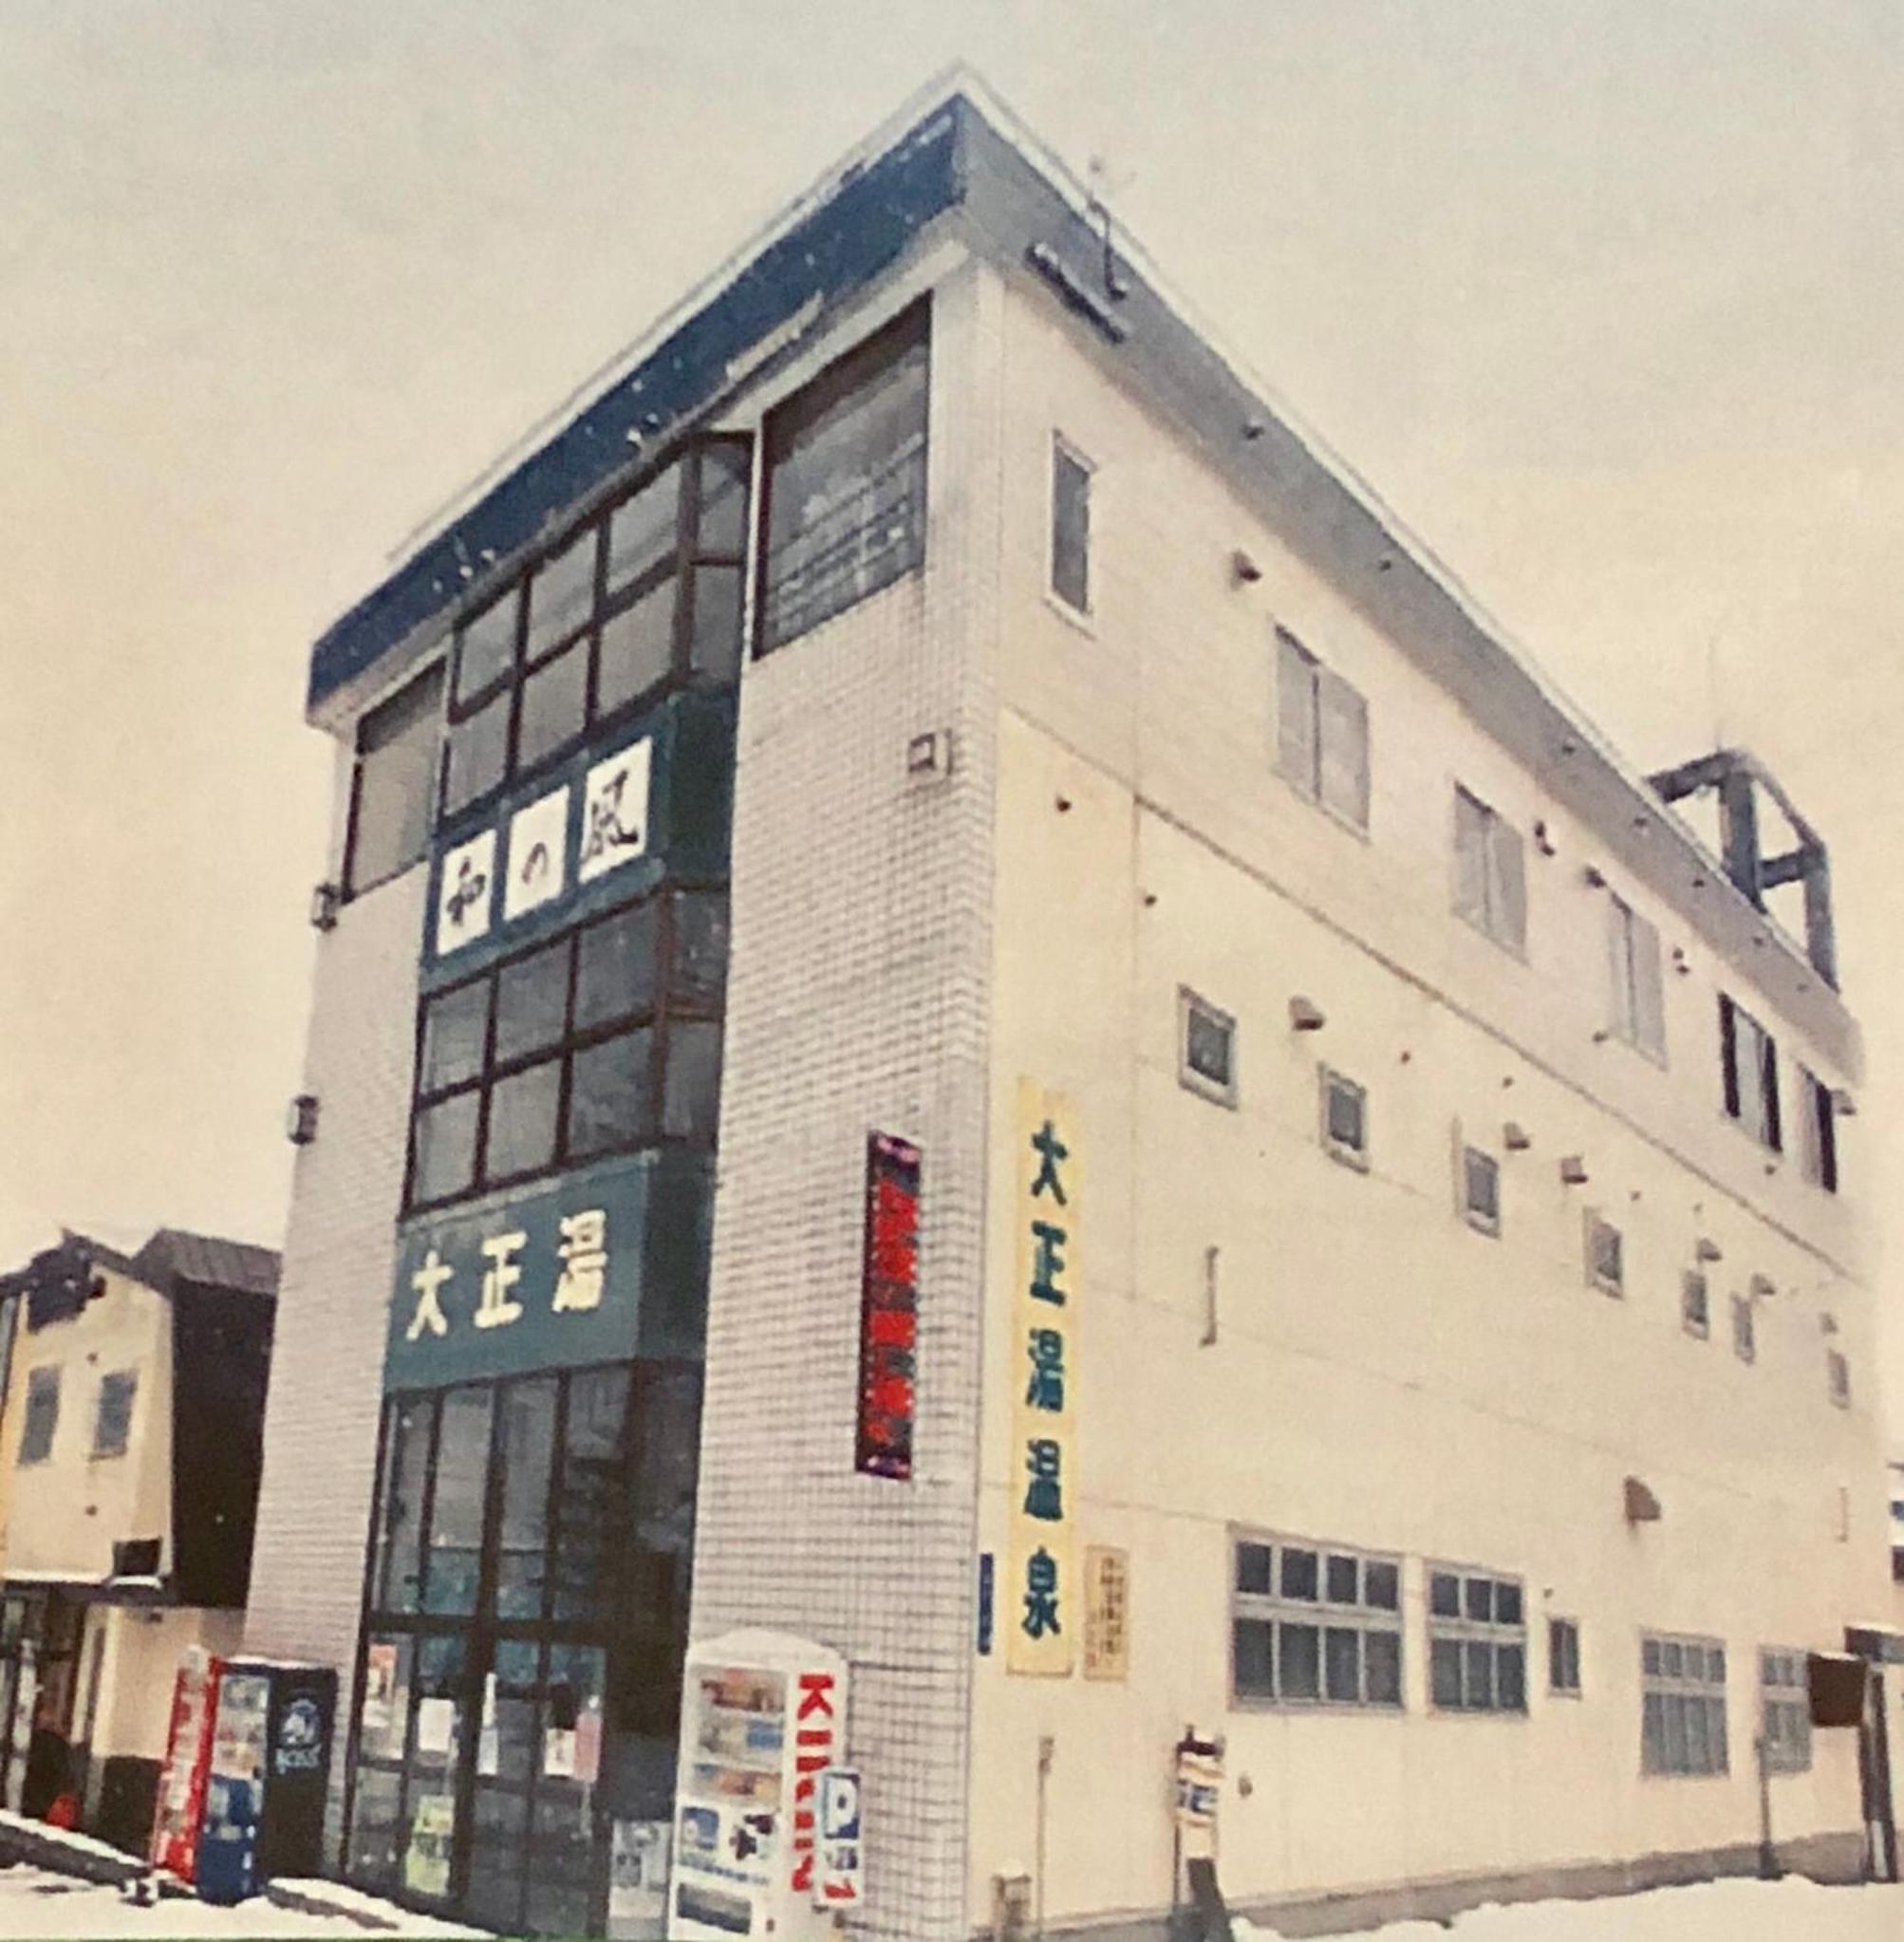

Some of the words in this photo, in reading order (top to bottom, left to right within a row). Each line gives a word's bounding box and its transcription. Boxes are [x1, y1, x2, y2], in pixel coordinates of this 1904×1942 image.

[405, 1209, 609, 1341] 大正湯
[1022, 1120, 1070, 1640] 大正湯温泉
